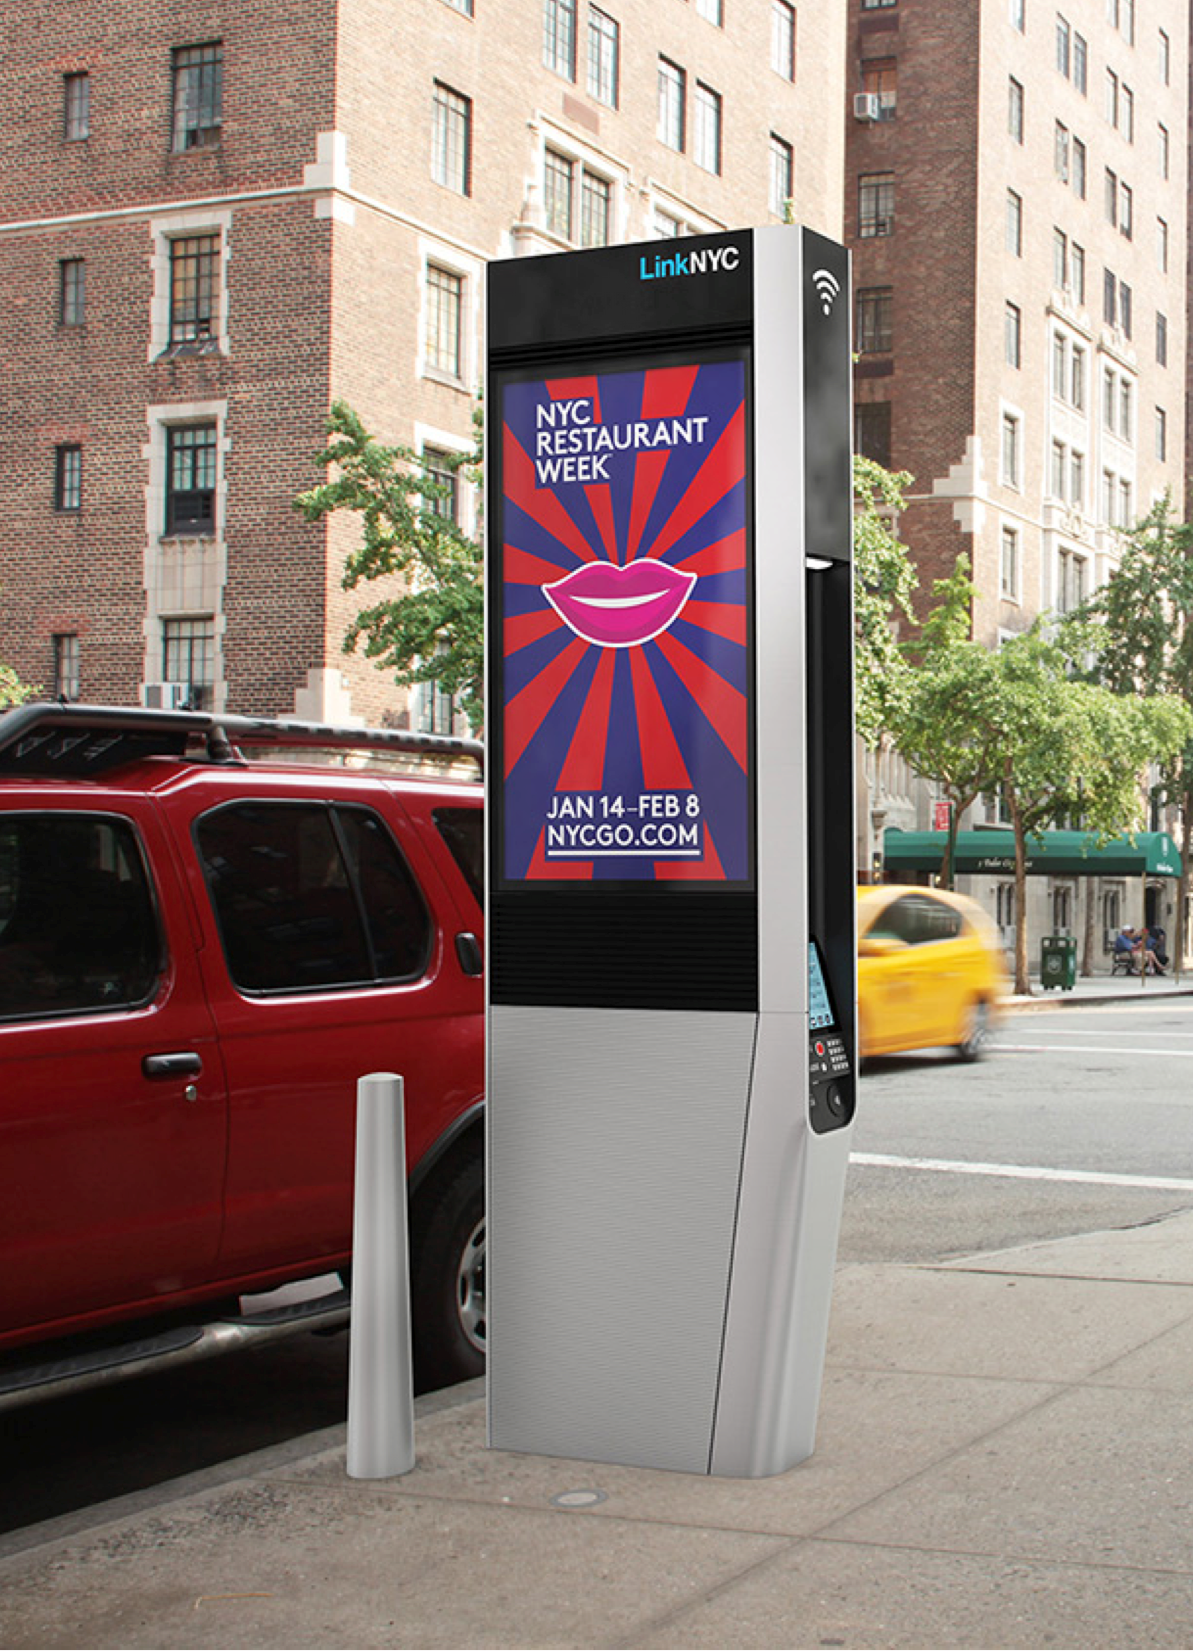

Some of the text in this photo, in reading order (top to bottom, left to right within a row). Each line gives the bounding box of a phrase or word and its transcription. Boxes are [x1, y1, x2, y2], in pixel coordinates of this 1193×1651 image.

[640, 247, 739, 280] LinkNYC
[536, 400, 591, 429] NYC
[536, 417, 709, 456] RESTAURANT
[536, 454, 610, 484] WEEK
[547, 795, 594, 819] JAN
[685, 793, 700, 818] 8
[548, 823, 698, 847] NYCGO.COM
